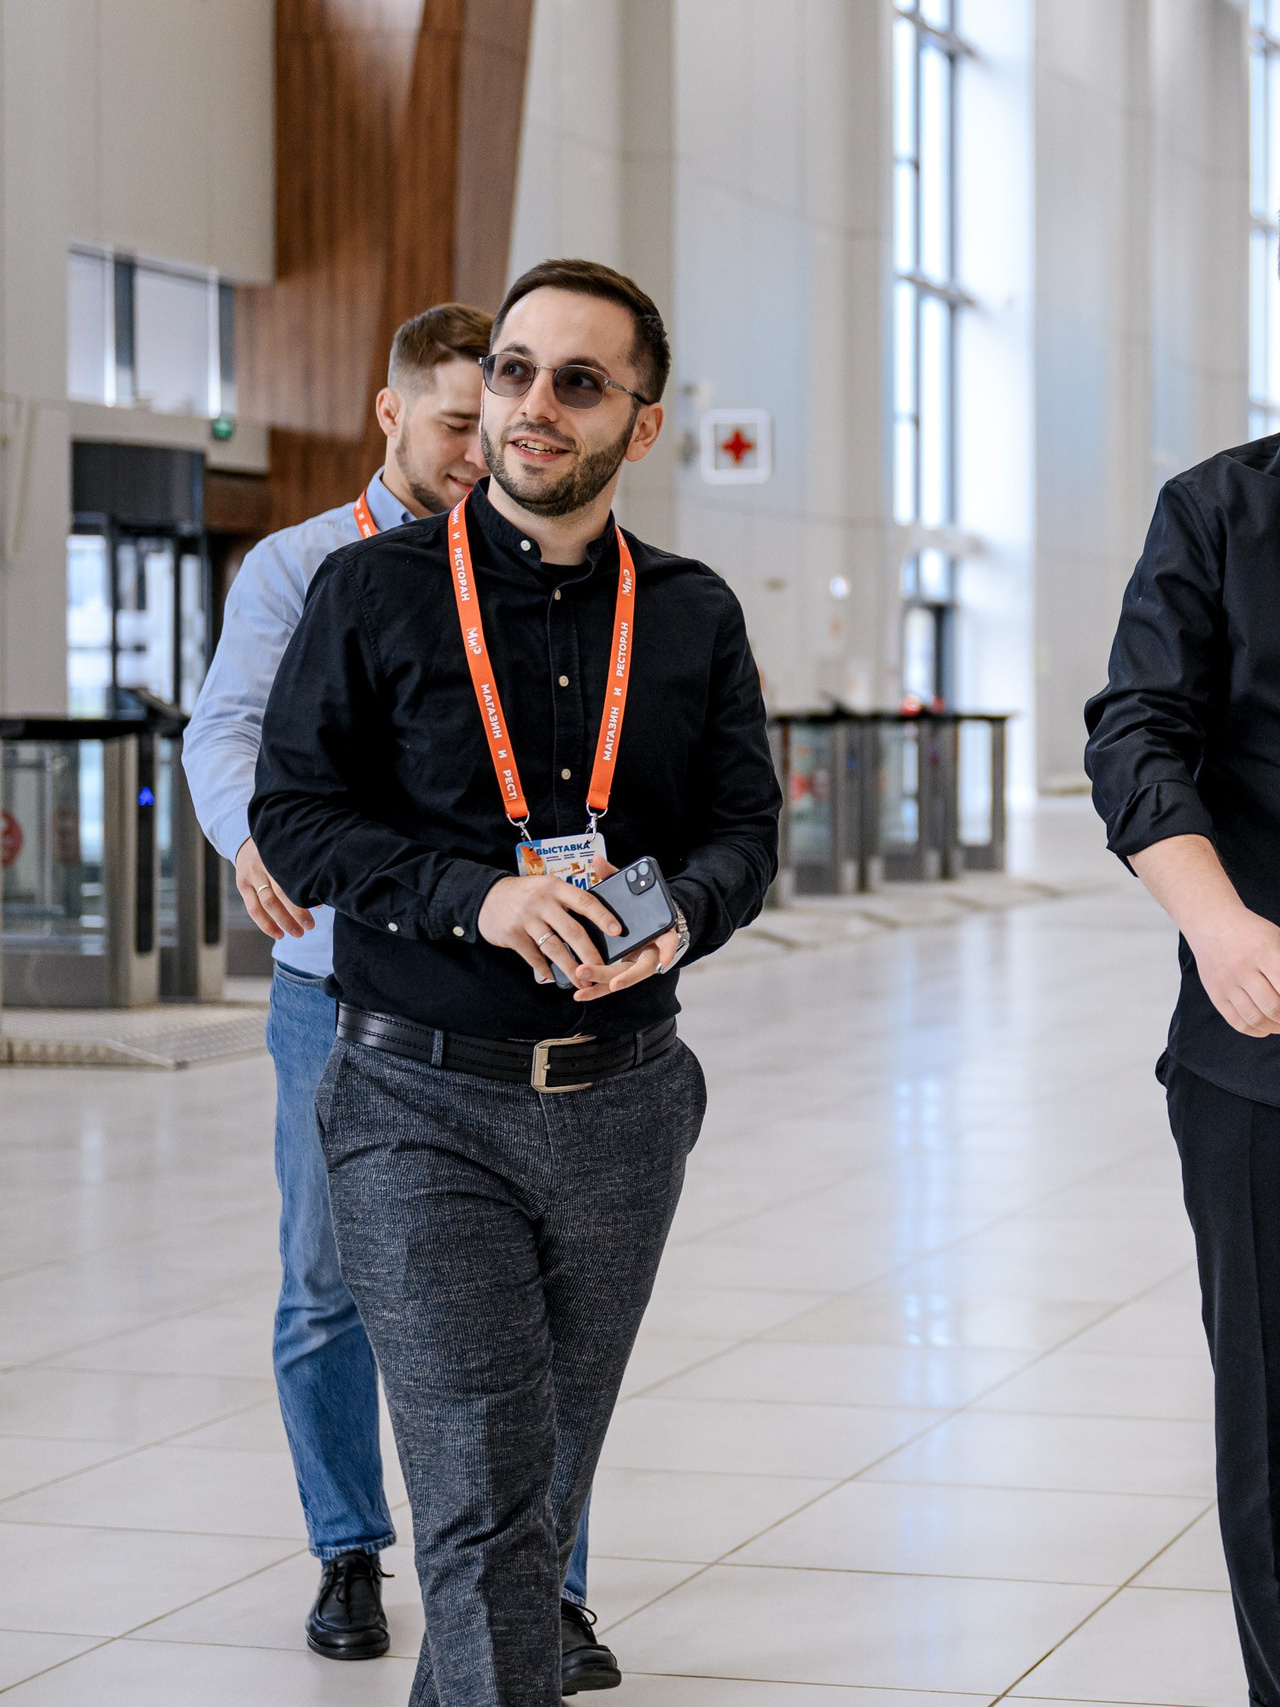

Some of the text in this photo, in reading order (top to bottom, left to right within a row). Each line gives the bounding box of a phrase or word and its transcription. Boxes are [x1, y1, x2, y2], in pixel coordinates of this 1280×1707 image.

[452, 531, 461, 540] И
[453, 547, 470, 602] РЕСТОРАН
[615, 622, 629, 677] РЕСТОРАН
[613, 687, 623, 696] И
[480, 683, 502, 739] МАГАЗИН
[602, 706, 620, 761] МАГАЗИН
[497, 749, 508, 759] И
[502, 769, 518, 799] РЕСТ
[536, 842, 590, 856] ВЫСТАВКА
